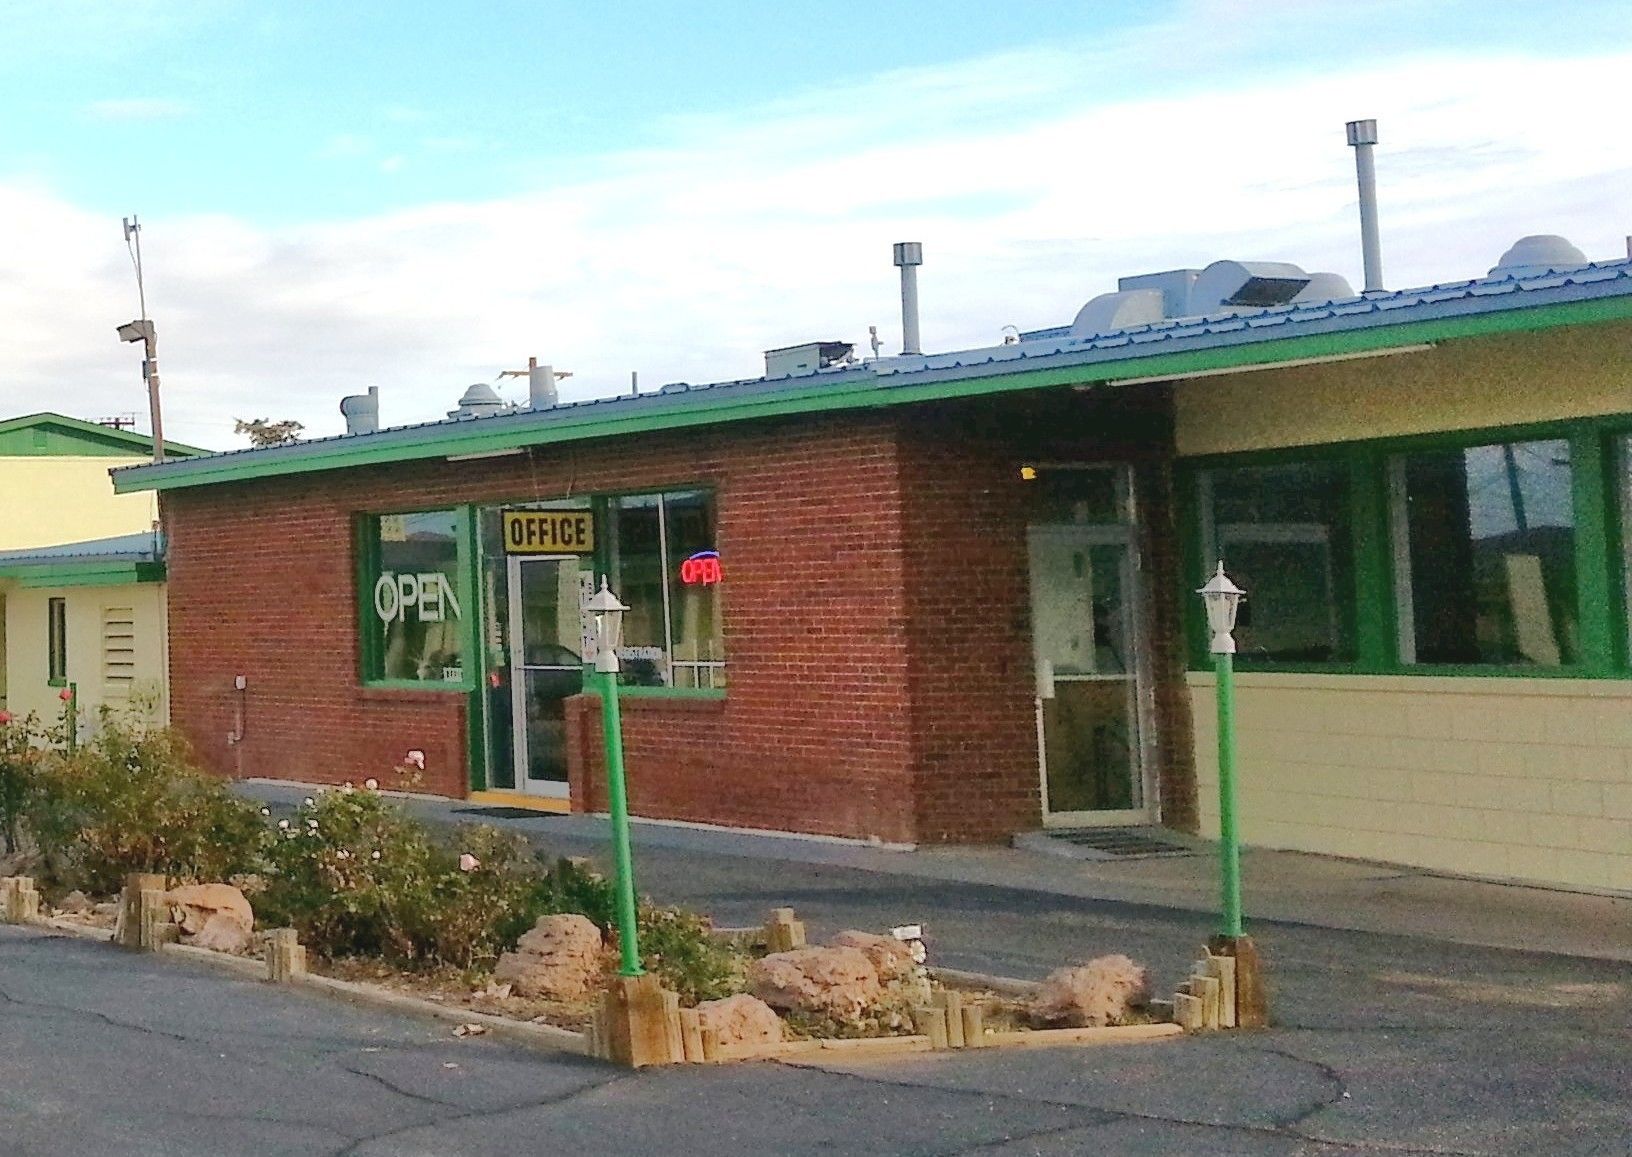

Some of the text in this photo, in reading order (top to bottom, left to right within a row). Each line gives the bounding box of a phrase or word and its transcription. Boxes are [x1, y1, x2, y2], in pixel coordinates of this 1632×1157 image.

[511, 518, 586, 546] OFFICE
[681, 558, 722, 584] OPEN
[374, 572, 462, 623] OPEN
